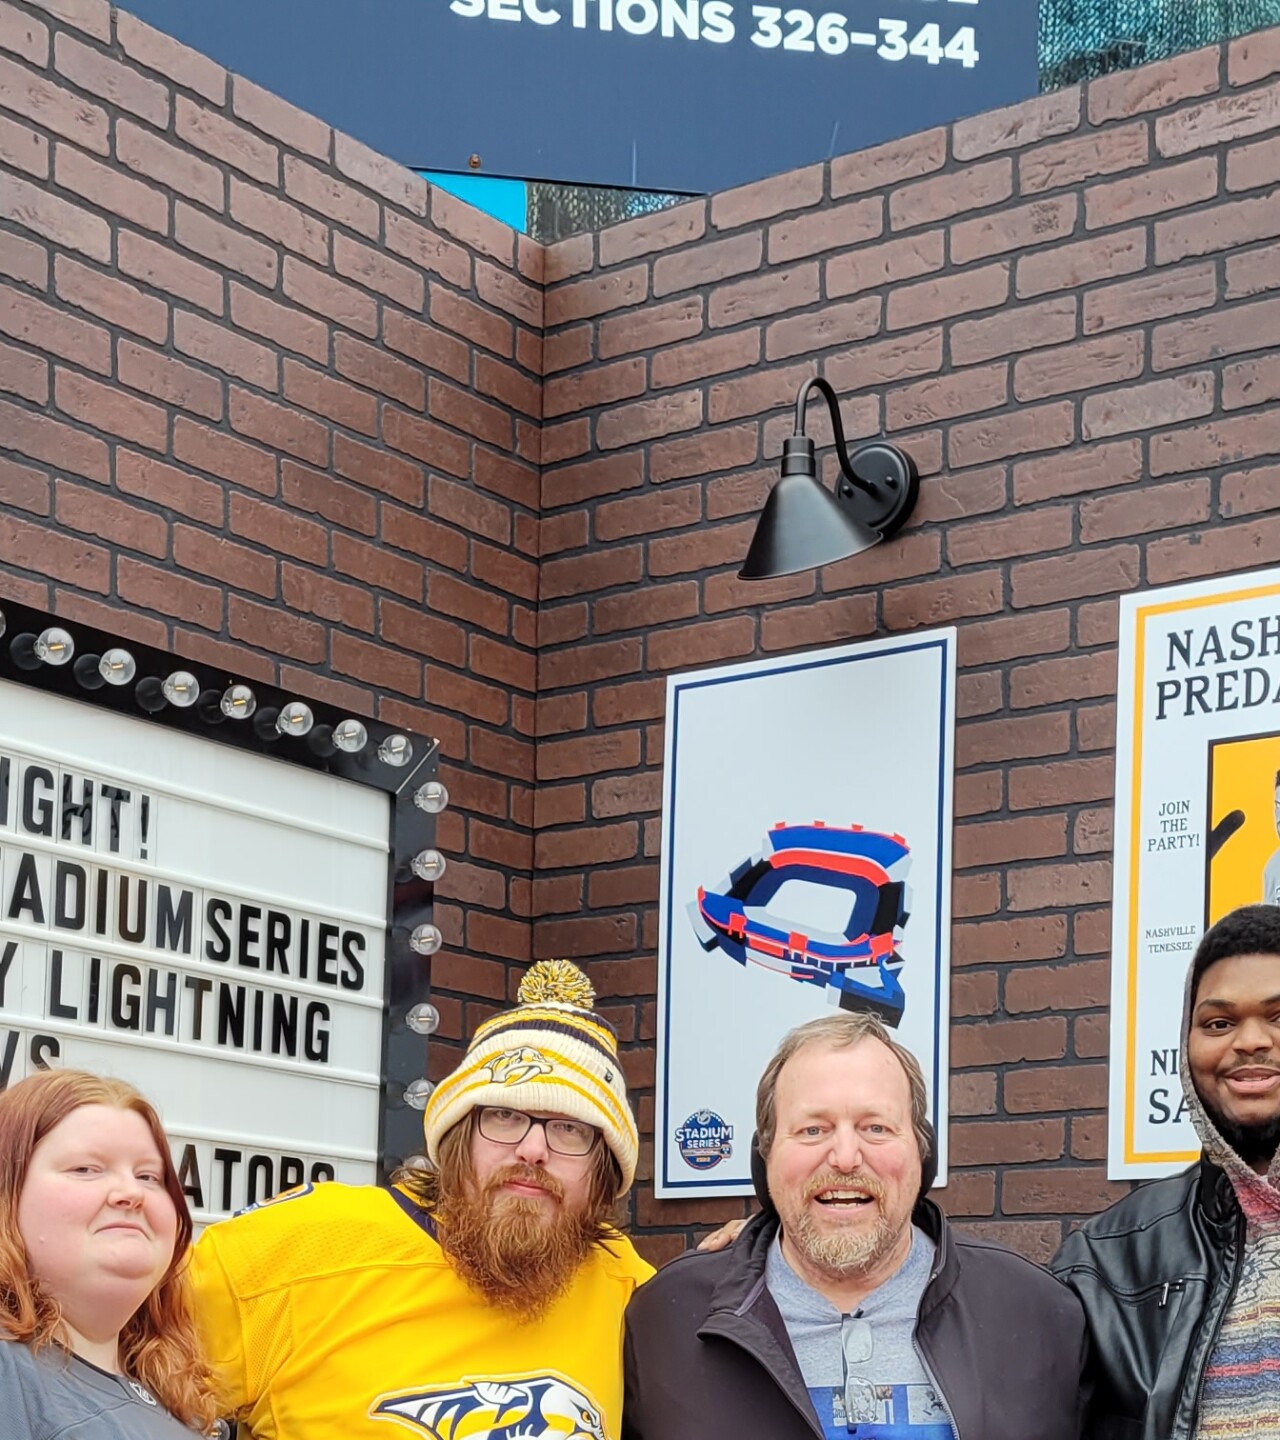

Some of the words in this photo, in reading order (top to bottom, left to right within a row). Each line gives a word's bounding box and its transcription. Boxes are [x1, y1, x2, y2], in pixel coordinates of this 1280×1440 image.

[1158, 800, 1190, 817] JOIN
[1160, 818, 1188, 833] THE
[1147, 834, 1200, 852] PARTY!
[1145, 925, 1196, 939] NASHVILLE
[1148, 941, 1193, 954] TENESSEE
[50, 950, 331, 1063] LIGHTNING
[674, 1126, 733, 1142] STADIUM
[686, 1139, 721, 1149] SERIES
